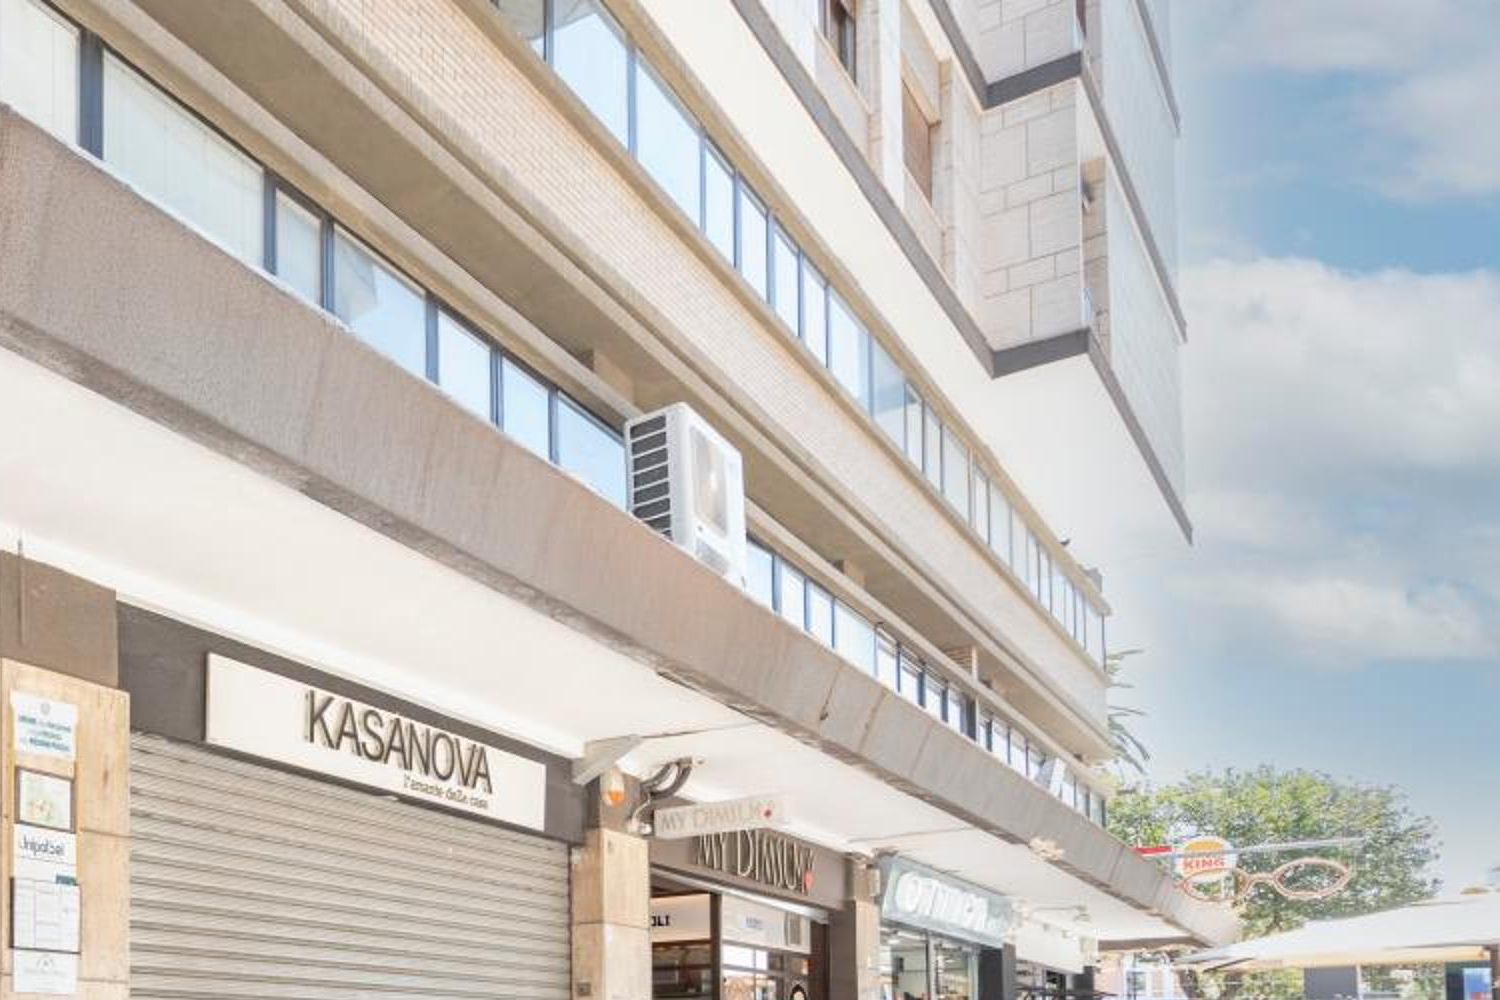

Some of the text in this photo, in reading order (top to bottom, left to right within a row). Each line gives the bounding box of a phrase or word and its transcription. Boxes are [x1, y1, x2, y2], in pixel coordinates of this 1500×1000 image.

[304, 689, 493, 795] KASANOVA
[660, 811, 685, 834] MY
[694, 831, 730, 873] MY
